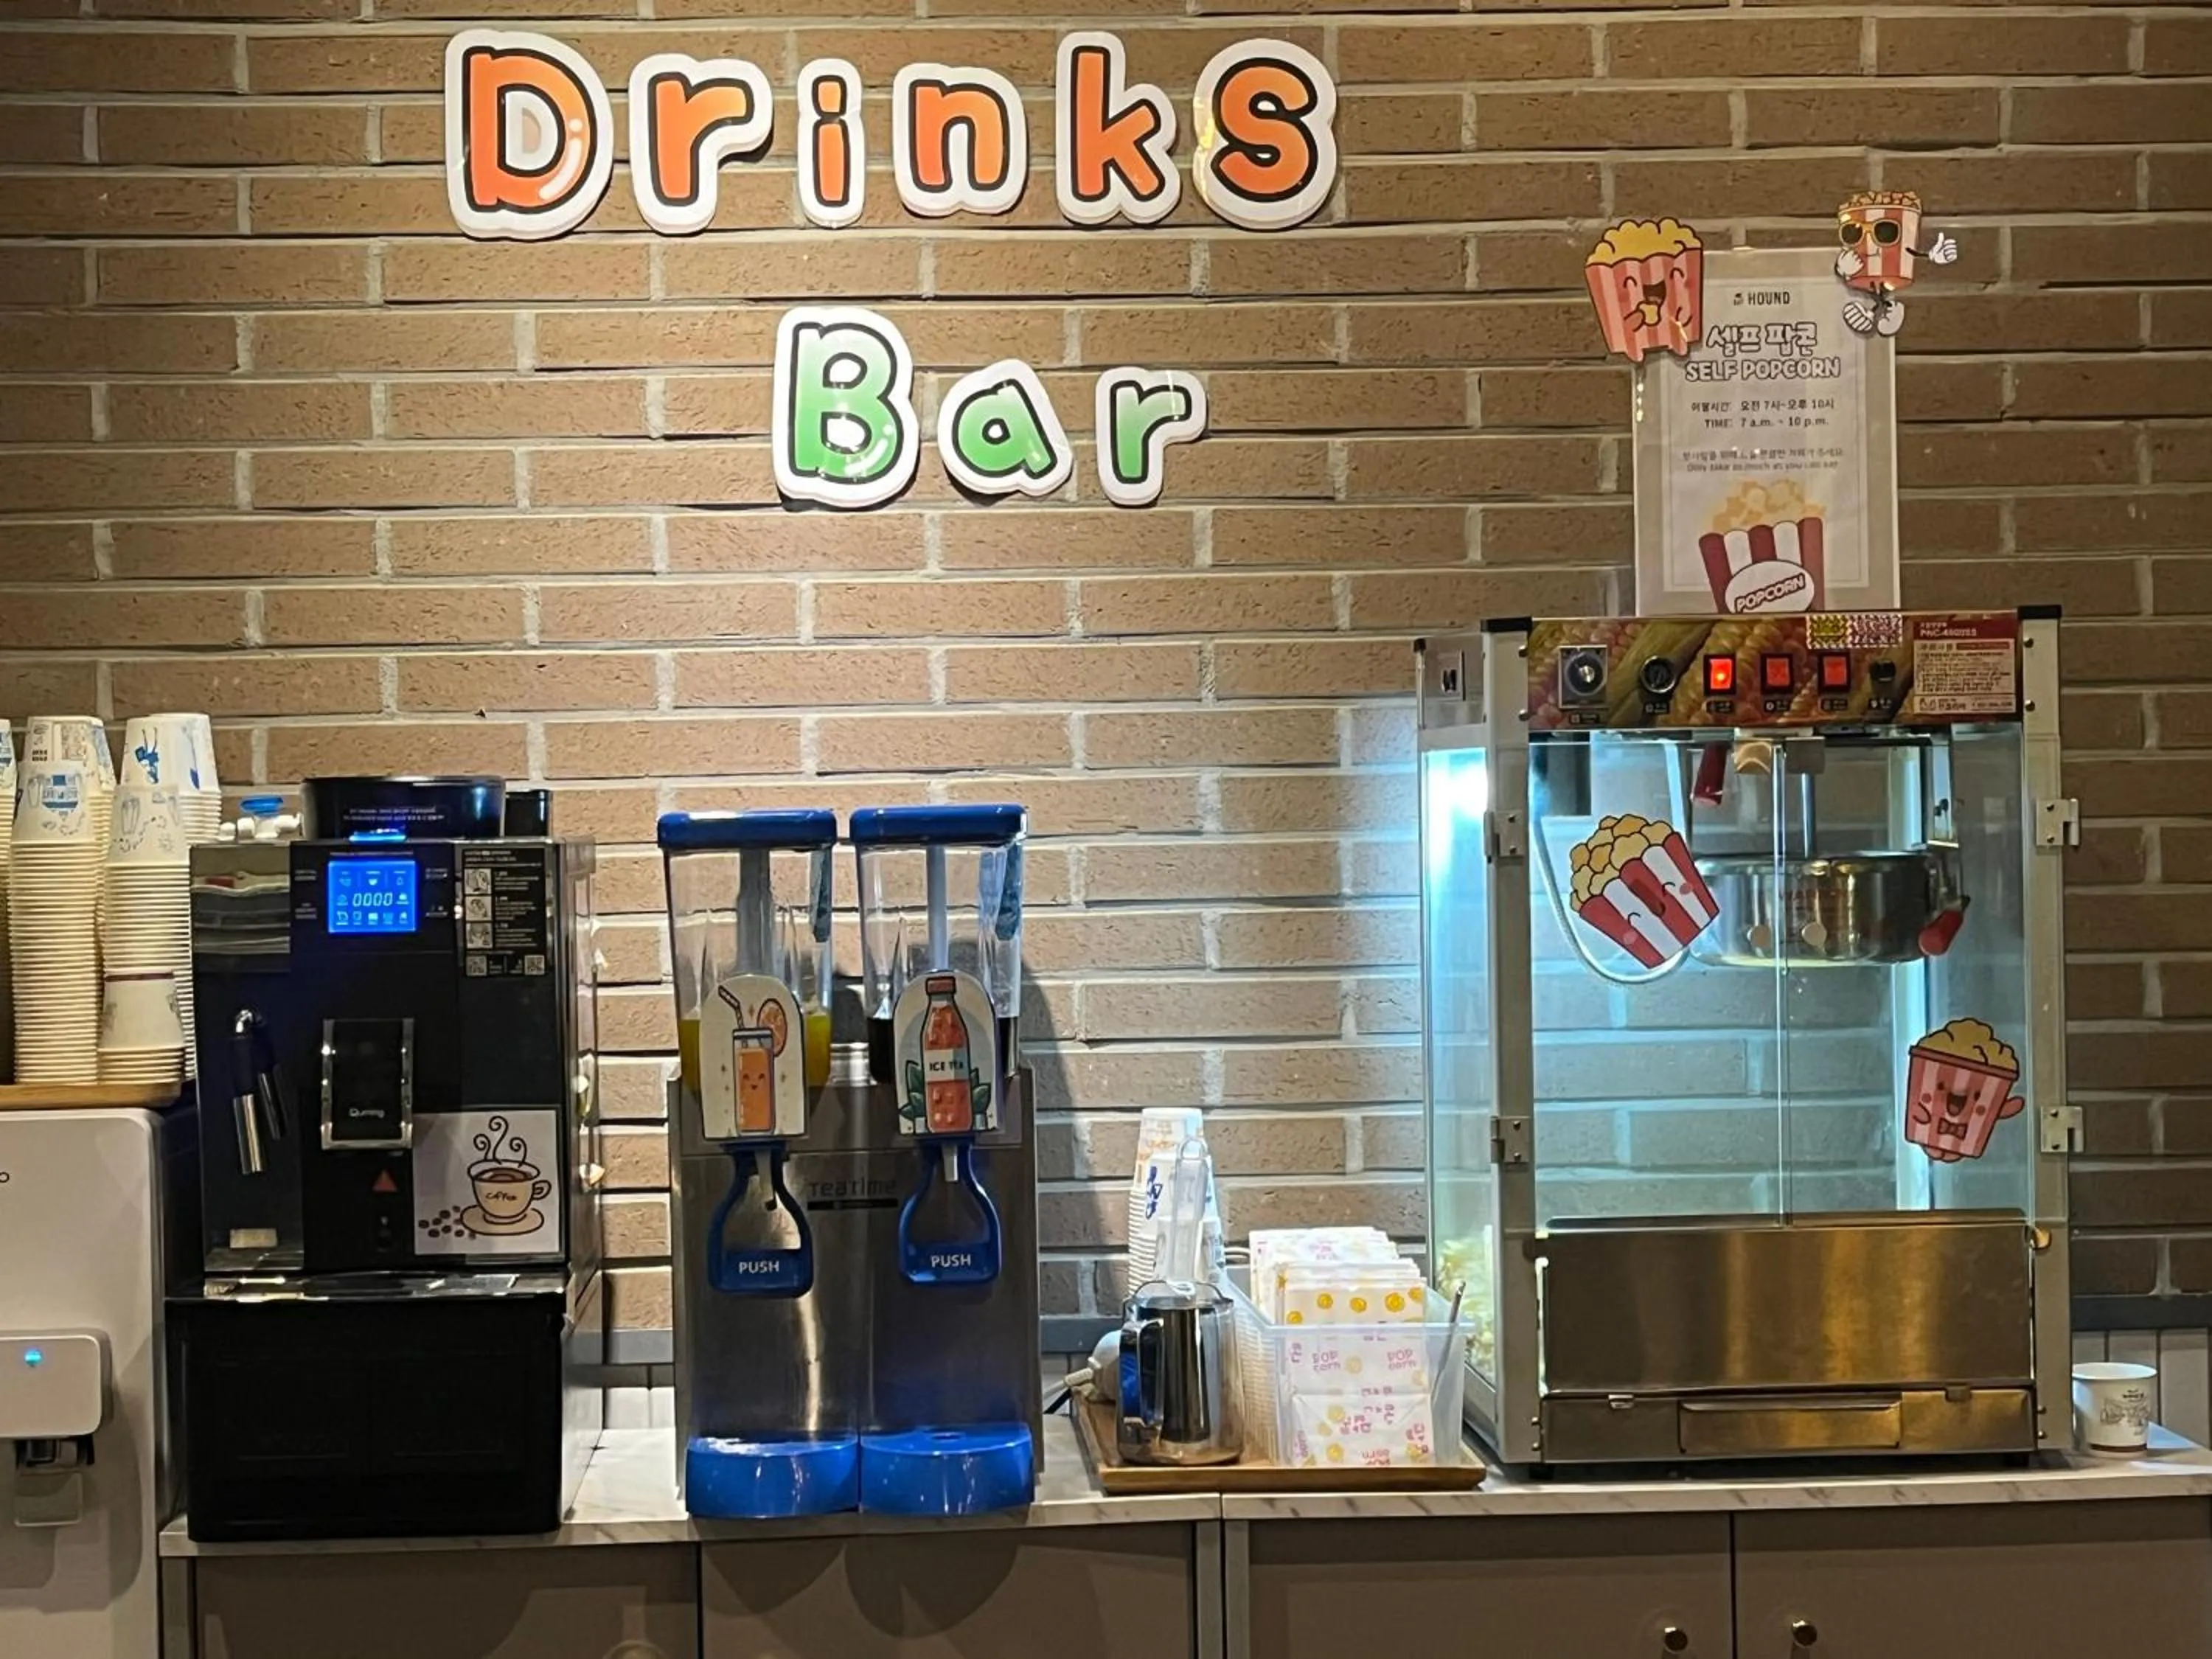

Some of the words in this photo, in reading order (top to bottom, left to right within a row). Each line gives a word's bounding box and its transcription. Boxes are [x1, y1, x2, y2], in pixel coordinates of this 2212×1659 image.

[453, 37, 1329, 220] Drinks
[1748, 291, 1790, 305] HOUND
[1706, 324, 1761, 357] 셀프
[1764, 321, 1818, 356] 팝콘
[1685, 359, 1737, 382] SELF
[1741, 357, 1841, 380] POPCORN
[780, 313, 1200, 495] Bar
[1788, 416, 1801, 427] 10
[1734, 572, 1806, 613] POPCORN
[352, 893, 393, 907] 0000
[929, 1061, 945, 1071] ICE
[739, 1261, 779, 1274] PUSH
[931, 1254, 971, 1267] PUSH
